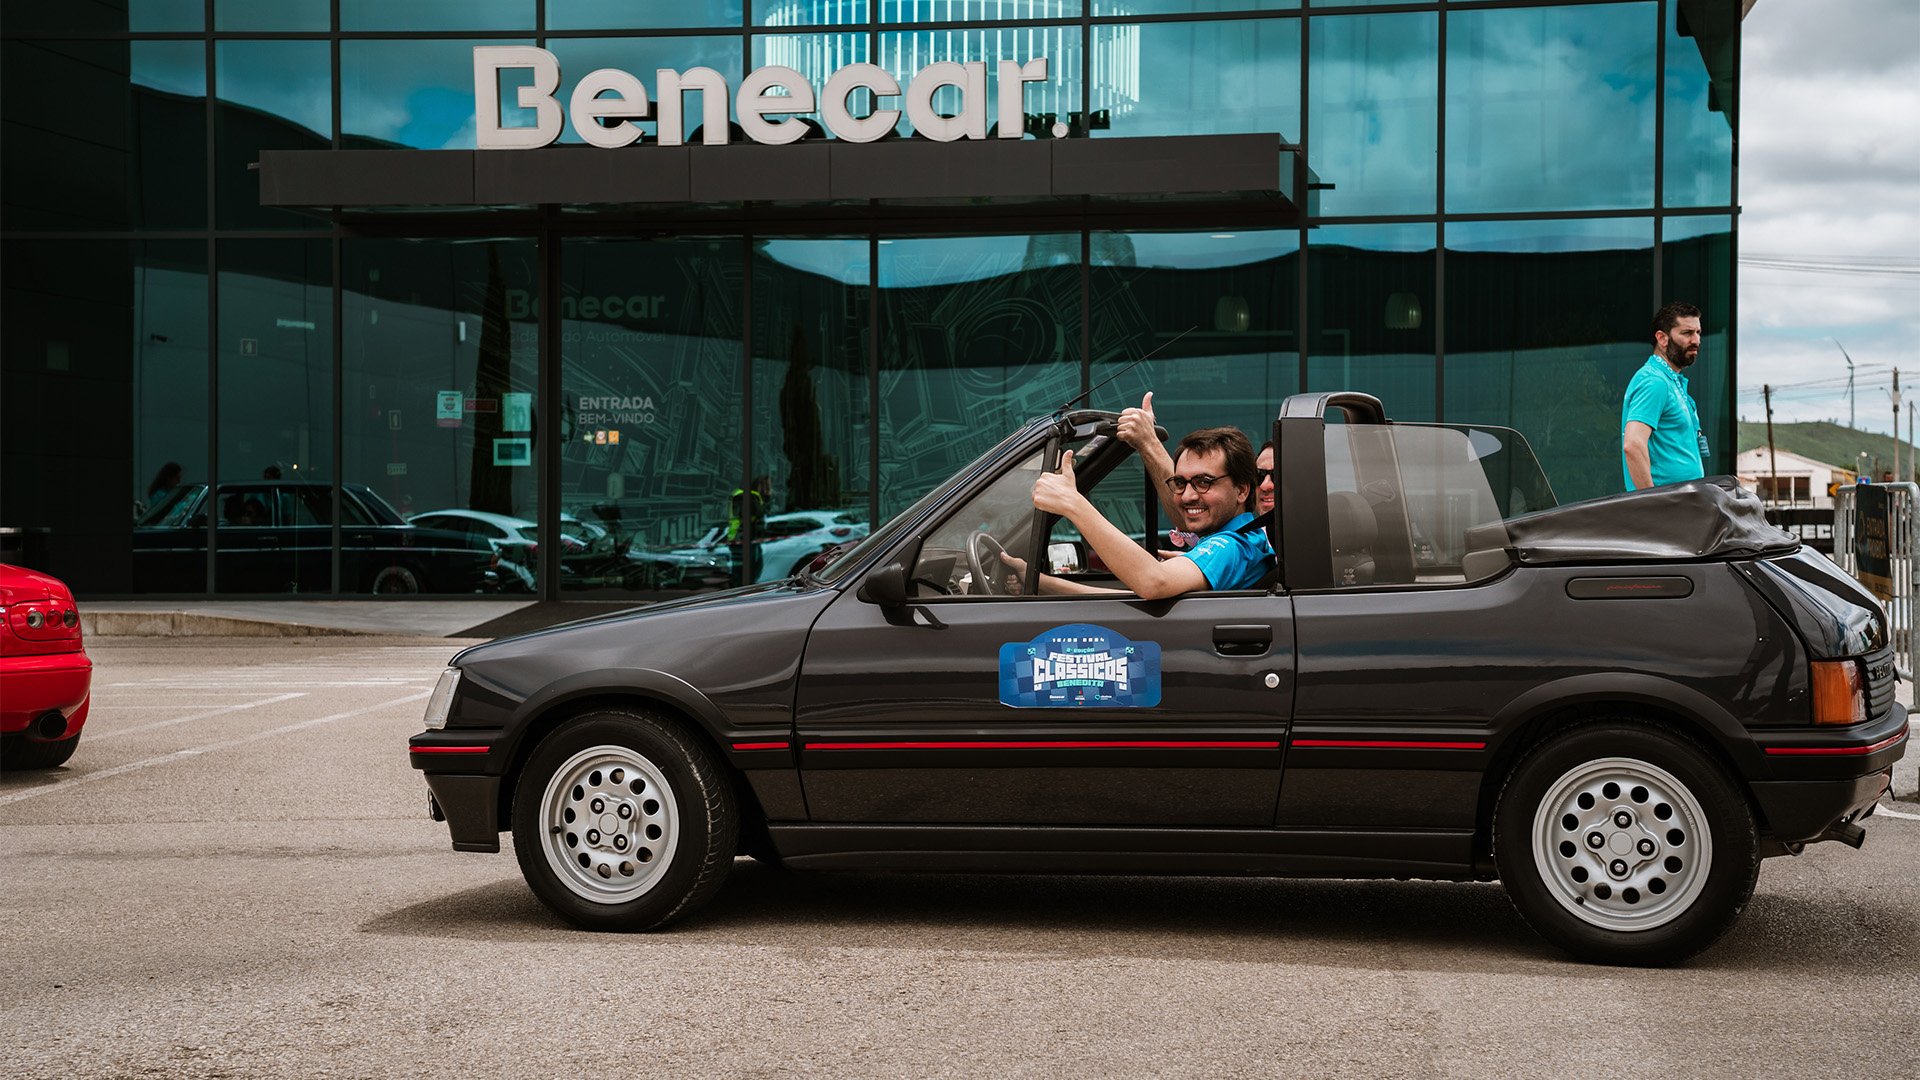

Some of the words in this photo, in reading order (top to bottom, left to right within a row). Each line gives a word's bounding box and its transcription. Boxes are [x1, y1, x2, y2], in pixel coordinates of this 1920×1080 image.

[579, 396, 654, 410] ENTRADA
[578, 412, 655, 425] BEM-VINDO
[1048, 651, 1113, 664] FESTIVAL
[1056, 680, 1105, 688] BENEDITA
